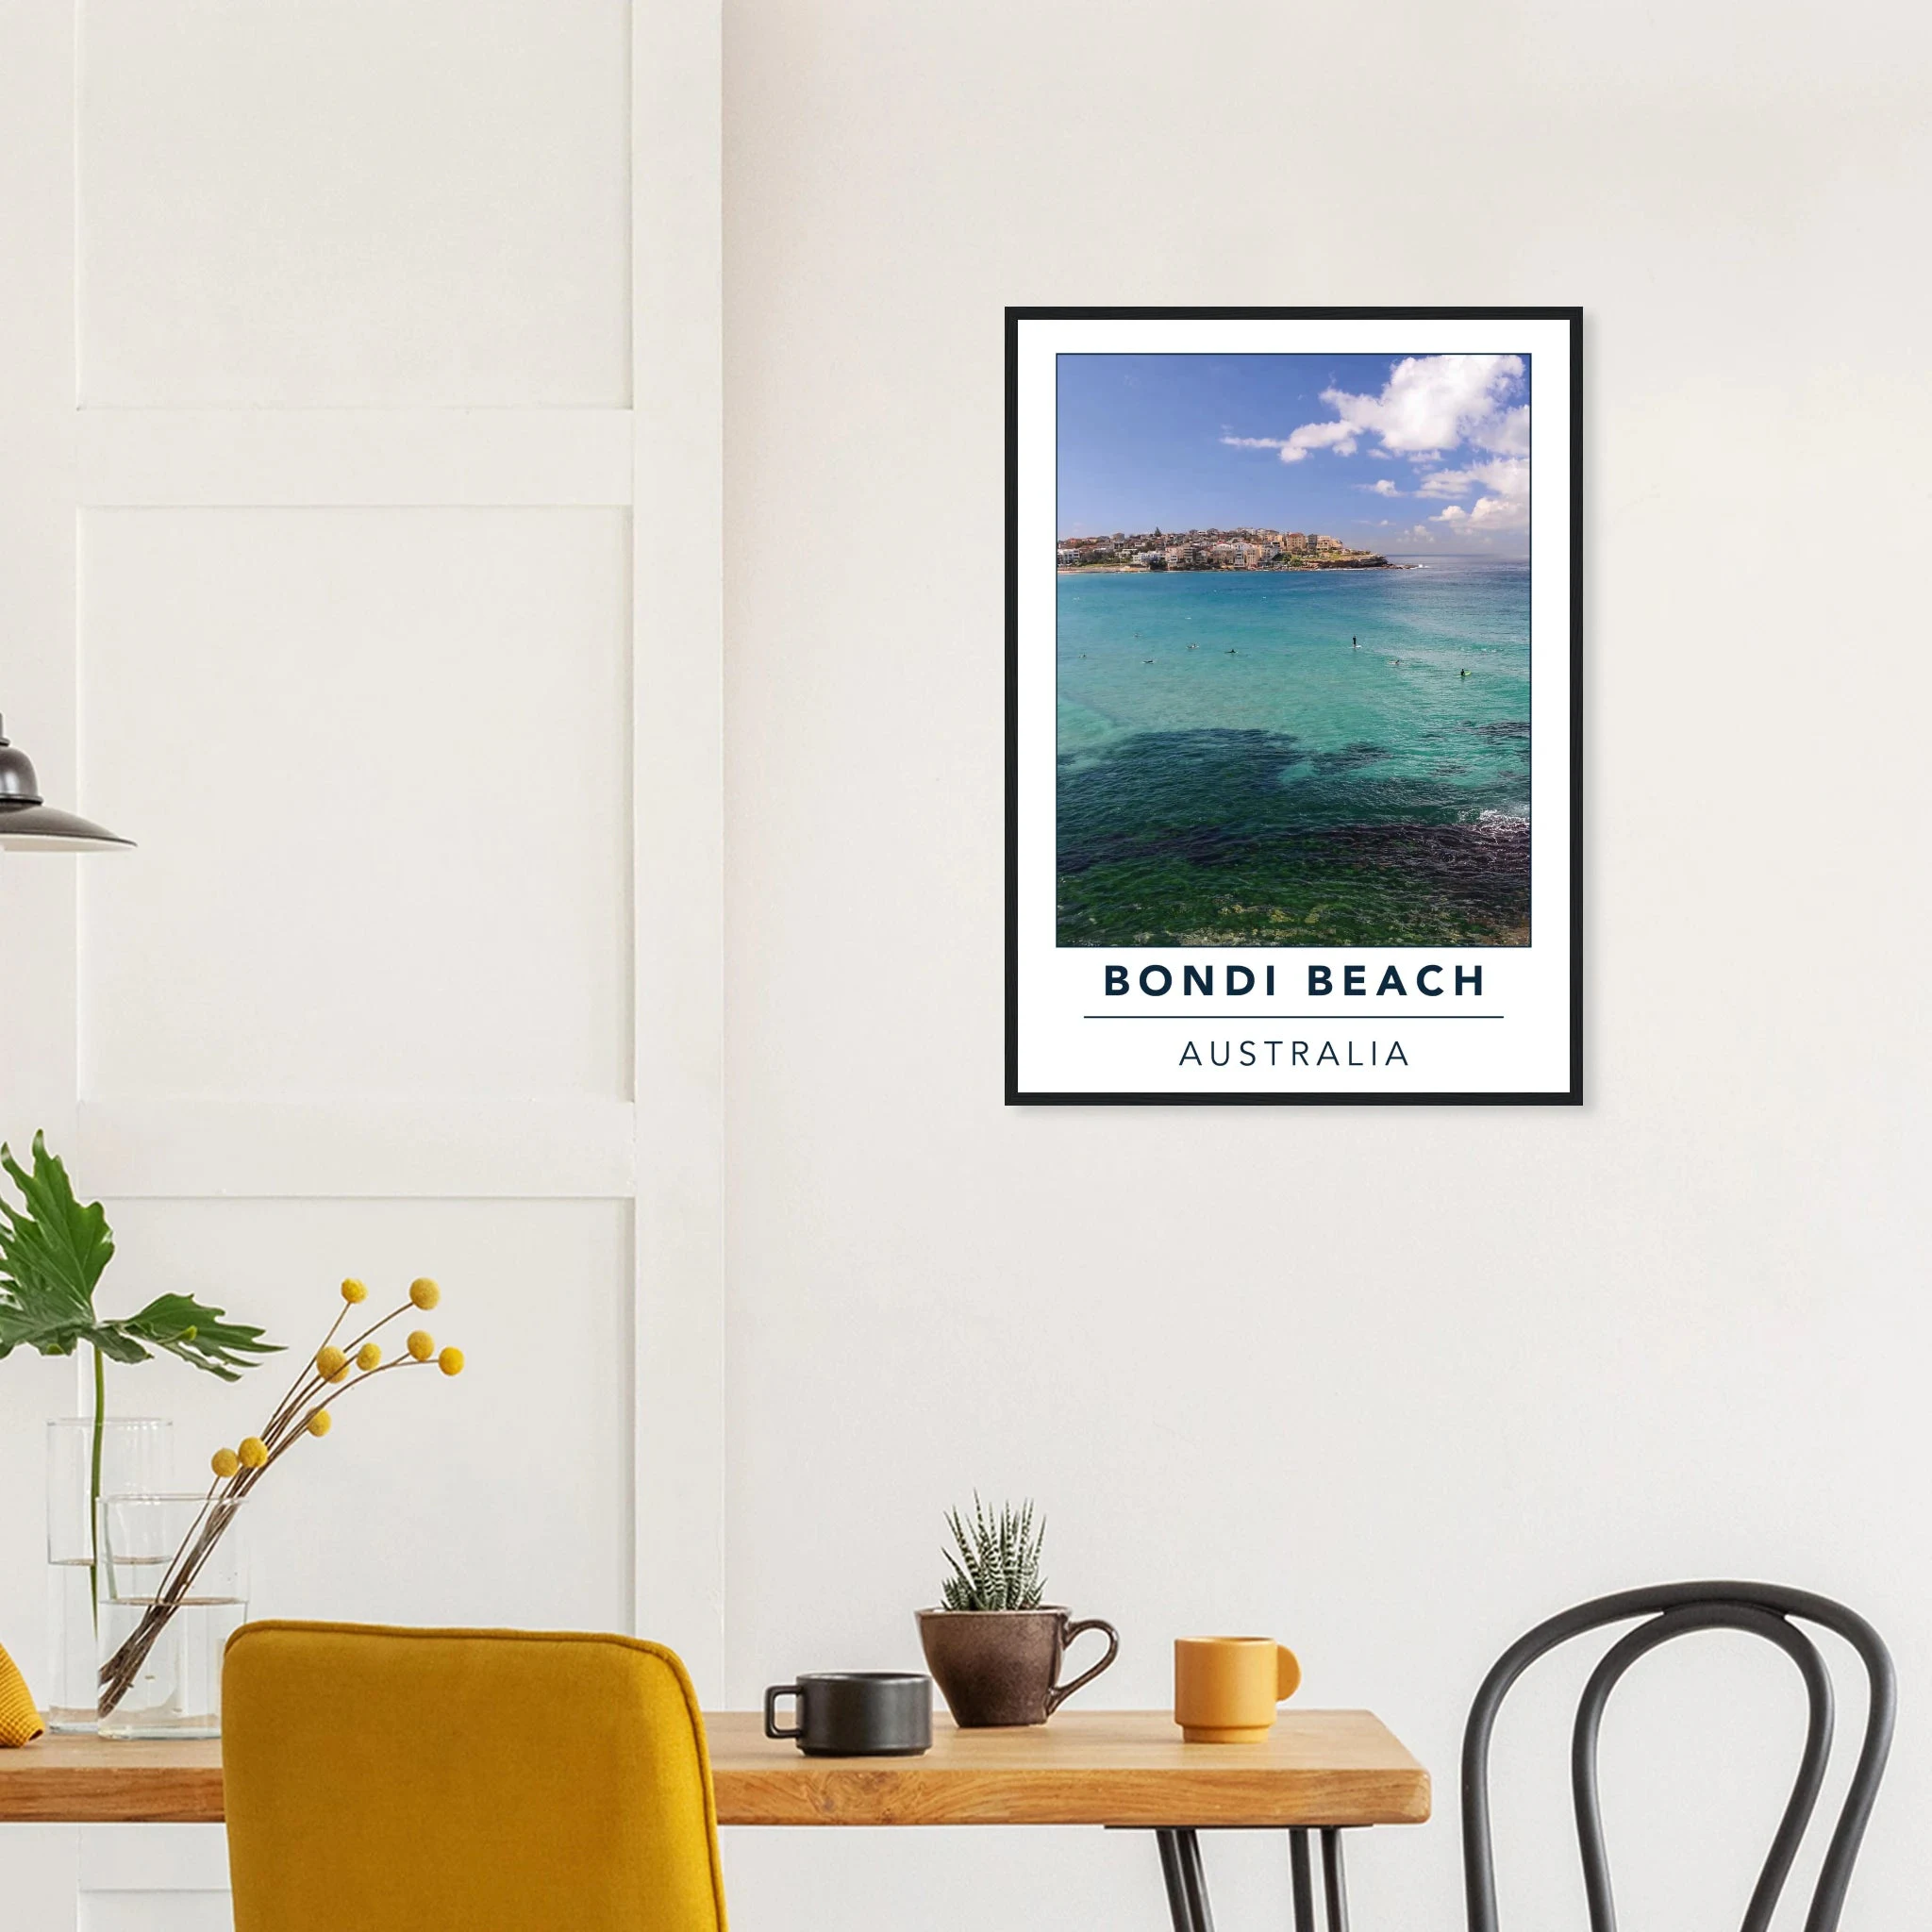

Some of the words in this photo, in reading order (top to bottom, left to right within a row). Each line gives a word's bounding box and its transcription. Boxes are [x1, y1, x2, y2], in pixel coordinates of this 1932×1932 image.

[1105, 964, 1274, 997] BONDI
[1307, 964, 1483, 997] BEACH
[1178, 1040, 1408, 1067] AUSTRALIA
